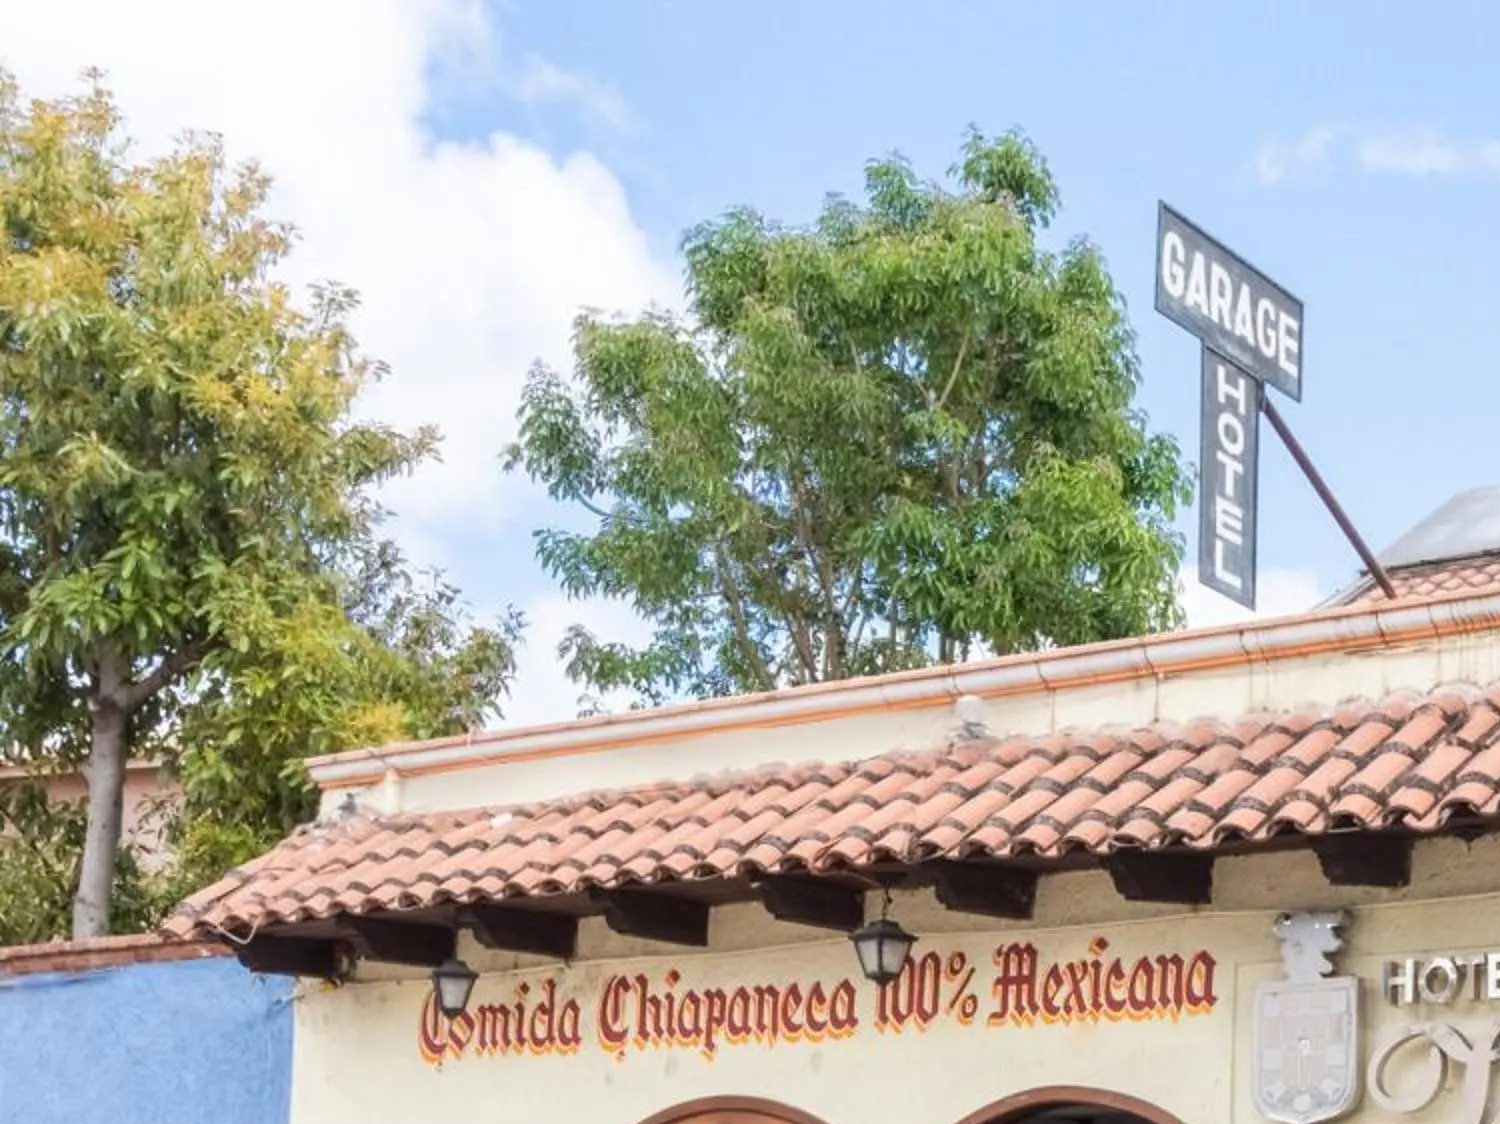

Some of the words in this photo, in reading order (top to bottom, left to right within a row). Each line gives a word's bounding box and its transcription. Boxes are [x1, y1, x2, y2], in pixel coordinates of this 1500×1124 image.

[1161, 230, 1299, 380] GARAGE
[1213, 364, 1245, 590] HOTEL
[598, 968, 859, 1061] Chiapaneca
[987, 936, 1217, 1027] Mexicana
